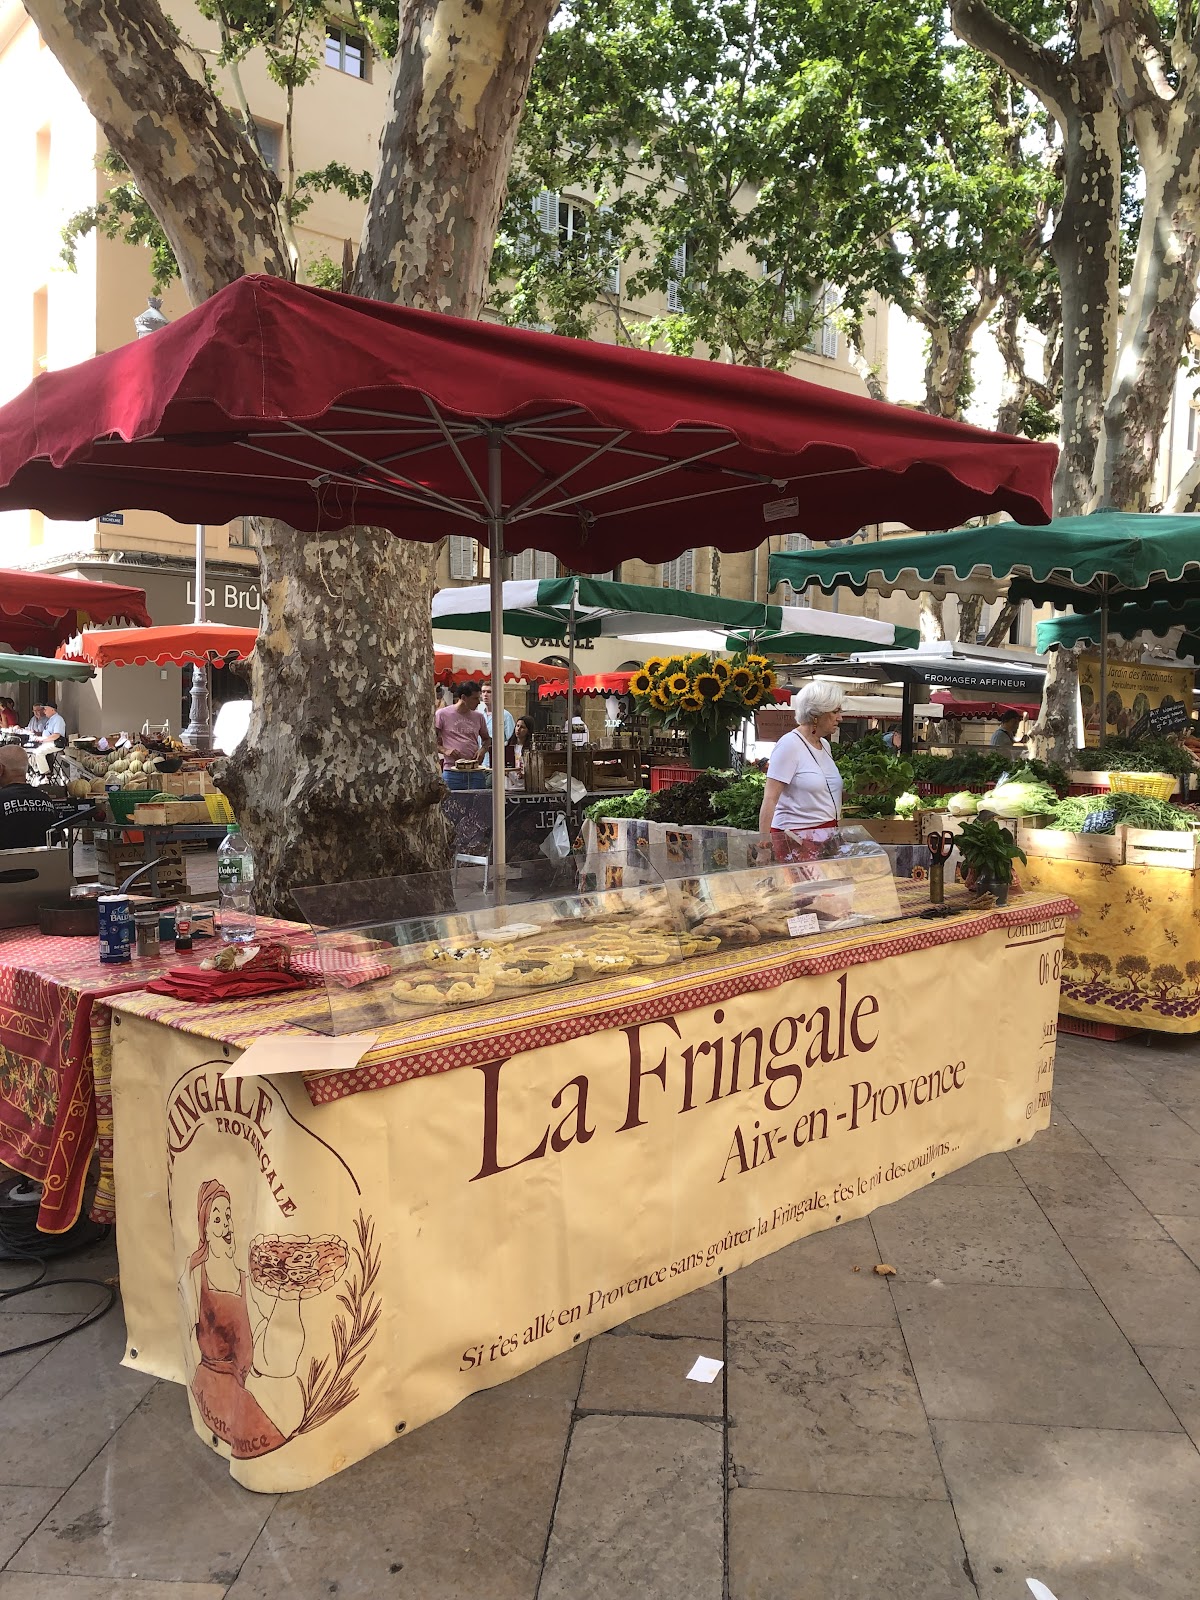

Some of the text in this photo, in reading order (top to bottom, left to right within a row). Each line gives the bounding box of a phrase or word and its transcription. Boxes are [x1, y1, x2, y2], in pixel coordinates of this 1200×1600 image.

[187, 581, 215, 607] La
[925, 673, 1026, 688] FROMAGER AFFINEUR
[1107, 667, 1128, 678] Jardin
[1129, 668, 1140, 680] des
[1007, 917, 1065, 939] Commandez
[469, 973, 880, 1183] La Fringale
[216, 1117, 297, 1219] PROVENÇALE
[459, 1344, 484, 1373] Si
[489, 1335, 519, 1363] t'es
[523, 1309, 555, 1345] allé
[558, 1305, 581, 1326] en
[586, 1266, 667, 1316] Provence
[669, 1249, 704, 1278] sans
[705, 1226, 756, 1268] goûter
[757, 1216, 768, 1239] la
[772, 1190, 830, 1231] Fringale,
[833, 1183, 855, 1204] t'es
[856, 1177, 868, 1197] le
[885, 1161, 906, 1182] des
